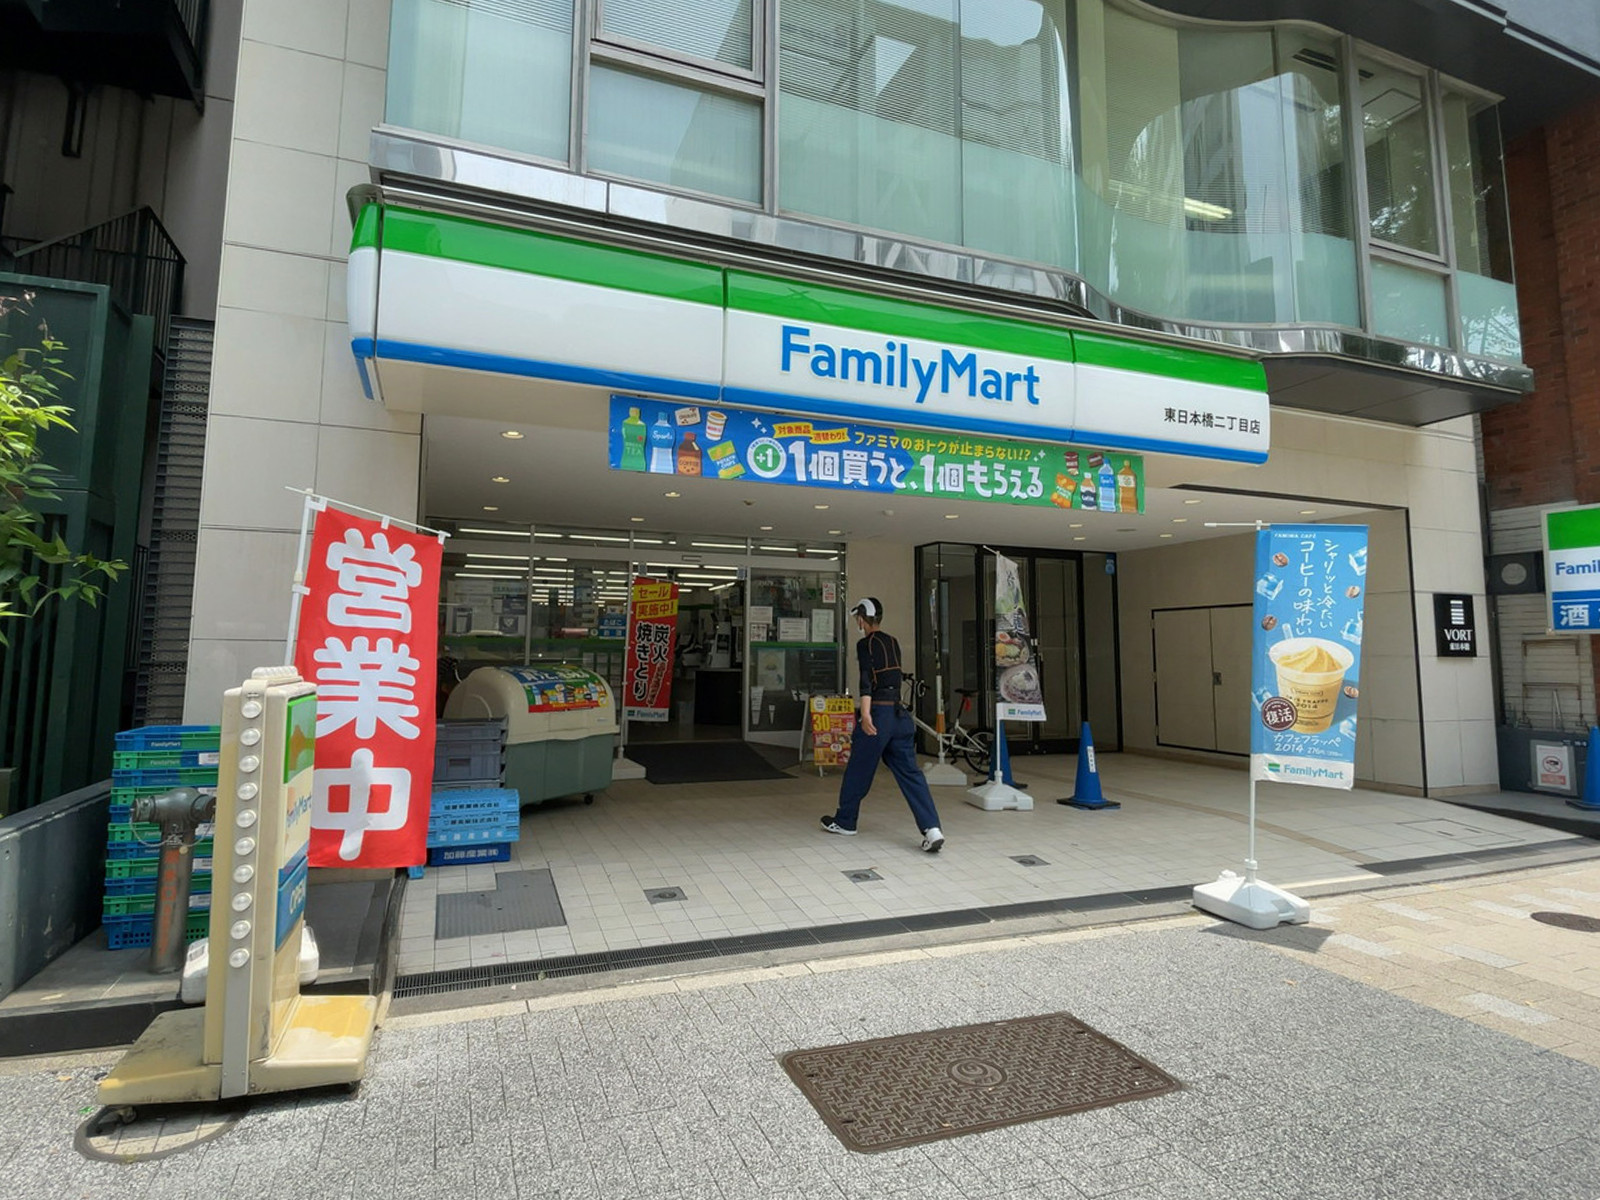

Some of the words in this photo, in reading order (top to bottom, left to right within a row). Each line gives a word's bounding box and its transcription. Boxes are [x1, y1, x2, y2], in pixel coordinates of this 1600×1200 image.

[780, 325, 1041, 405] FamilyMart
[1164, 407, 1261, 435] 東日本橋二丁目店
[652, 430, 673, 441] Sports
[777, 424, 811, 435] 対象商品
[626, 446, 642, 456] TEA
[1293, 541, 1316, 635] コーヒーの味わい
[1317, 539, 1339, 629] シャリッと冷たい
[638, 587, 669, 599] セール
[638, 601, 674, 616] 実施中!
[1443, 629, 1473, 641] VORT
[652, 625, 670, 665] 炭火
[633, 622, 652, 700] 焼きとり
[311, 528, 423, 861] 営業中
[812, 714, 830, 731] 30
[1265, 707, 1293, 725] 復活
[1274, 732, 1342, 748] カフェフラッペ
[1274, 743, 1304, 754] 2014
[1283, 764, 1344, 780] FamilyMart
